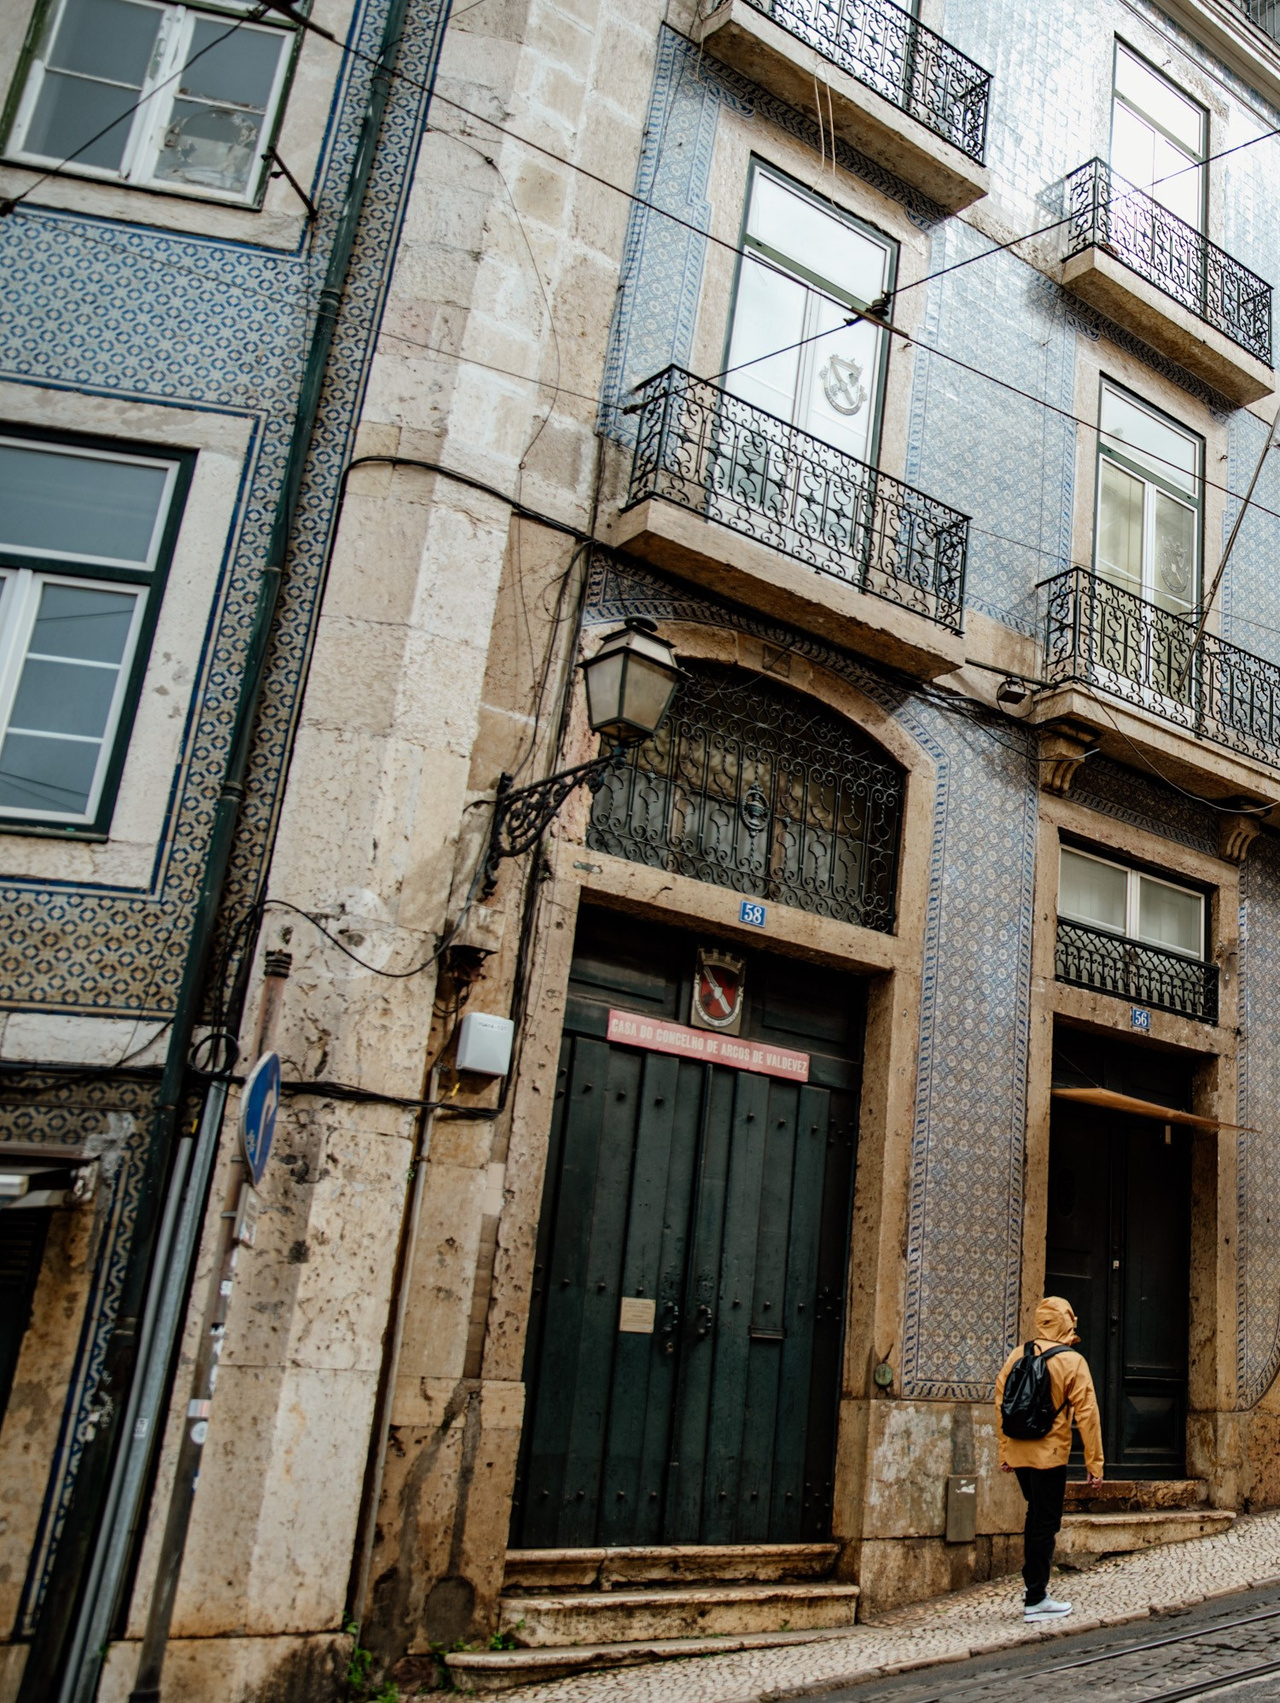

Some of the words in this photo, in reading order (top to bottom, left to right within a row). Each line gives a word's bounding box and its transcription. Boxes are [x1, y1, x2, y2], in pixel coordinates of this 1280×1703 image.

[744, 904, 763, 924] 58
[1135, 1011, 1147, 1026] 56
[611, 1018, 637, 1037] CASA
[641, 1024, 654, 1039] DO
[656, 1028, 704, 1051] CONCELHO
[707, 1039, 719, 1054] DE
[721, 1042, 750, 1061] ARCOS
[753, 1049, 764, 1064] DE
[766, 1052, 807, 1074] VALDEVEZ
